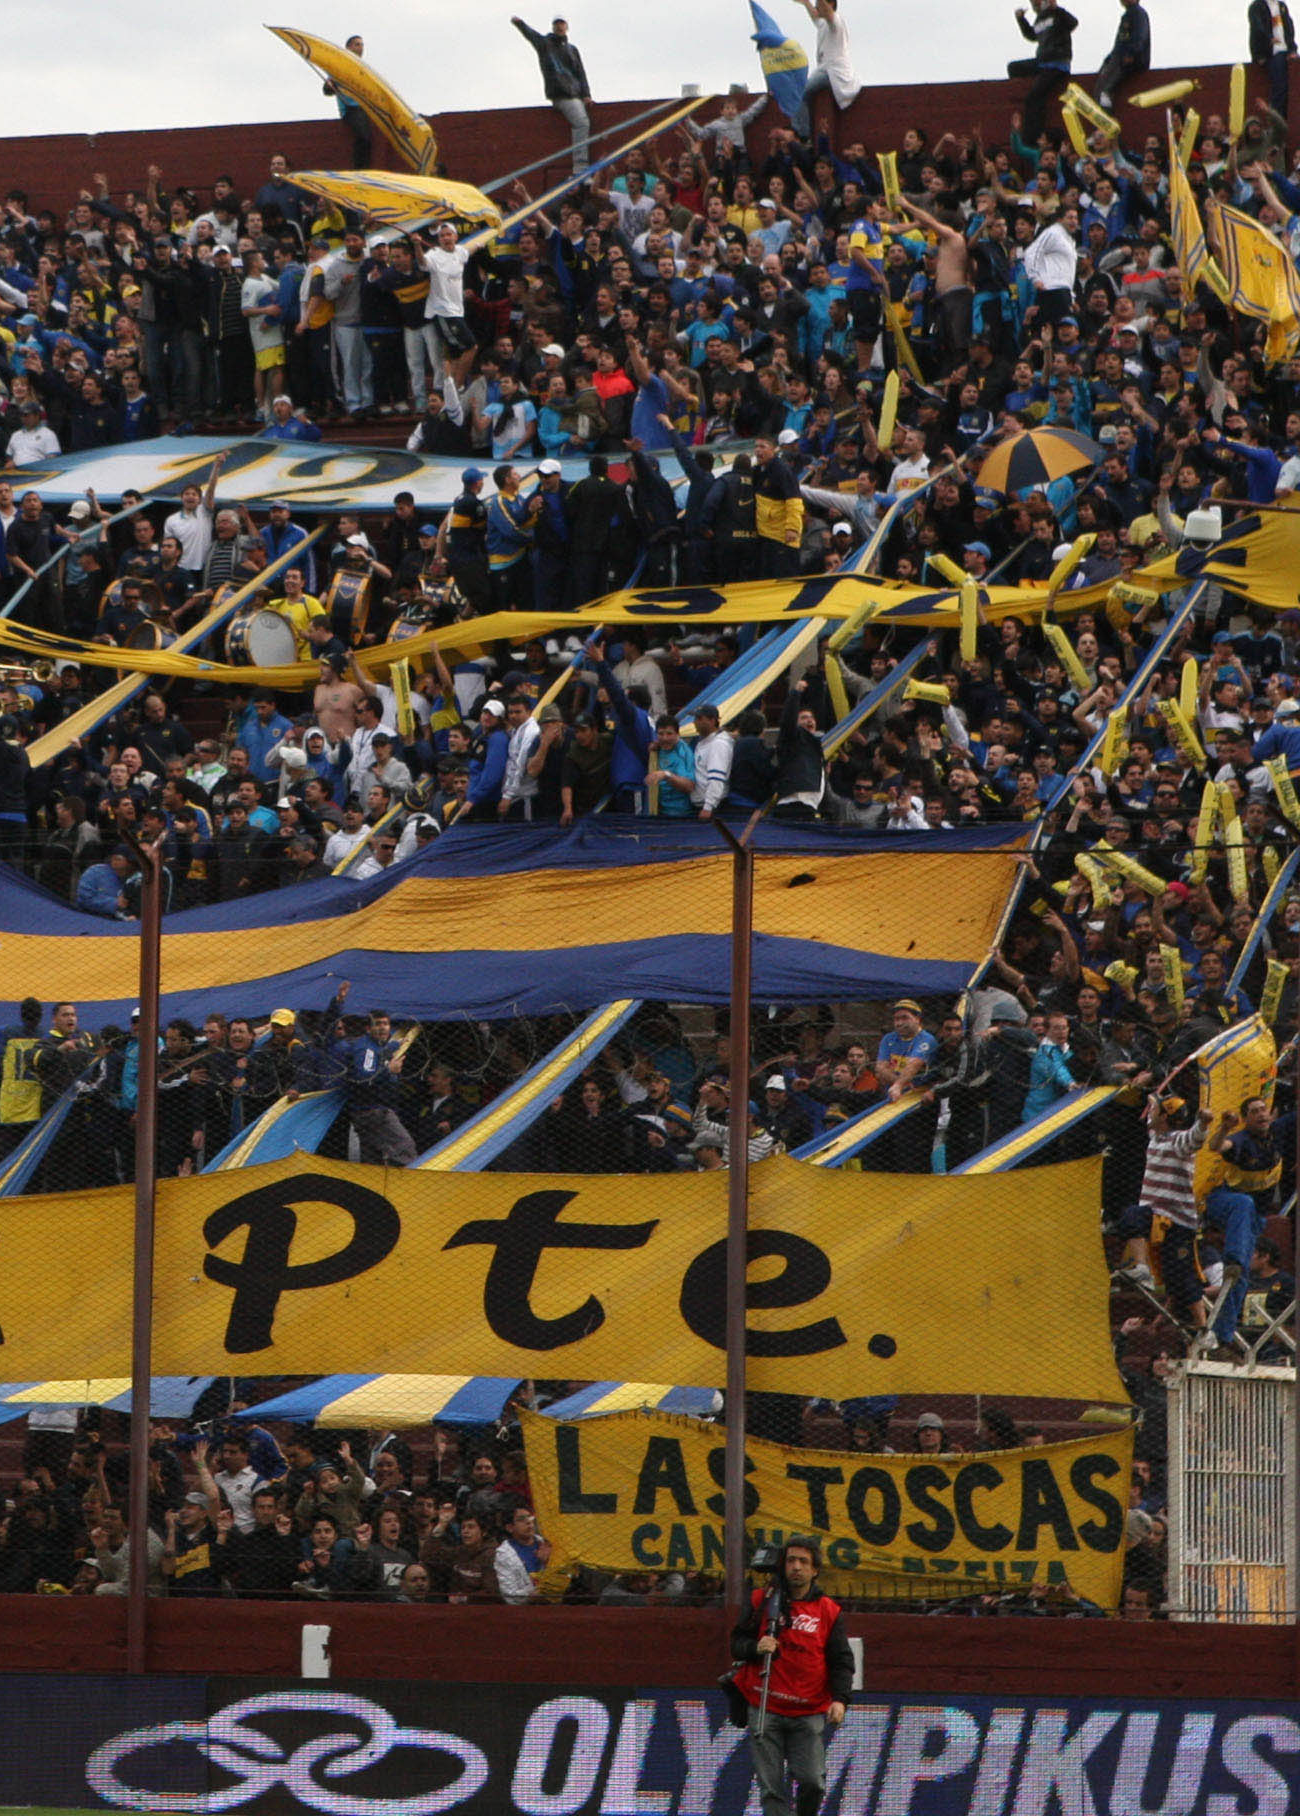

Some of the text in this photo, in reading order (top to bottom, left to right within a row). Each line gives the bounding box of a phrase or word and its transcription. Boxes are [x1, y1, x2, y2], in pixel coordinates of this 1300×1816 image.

[203, 1173, 897, 1358] Pte.
[555, 1426, 1123, 1553] LAS TOSCAS
